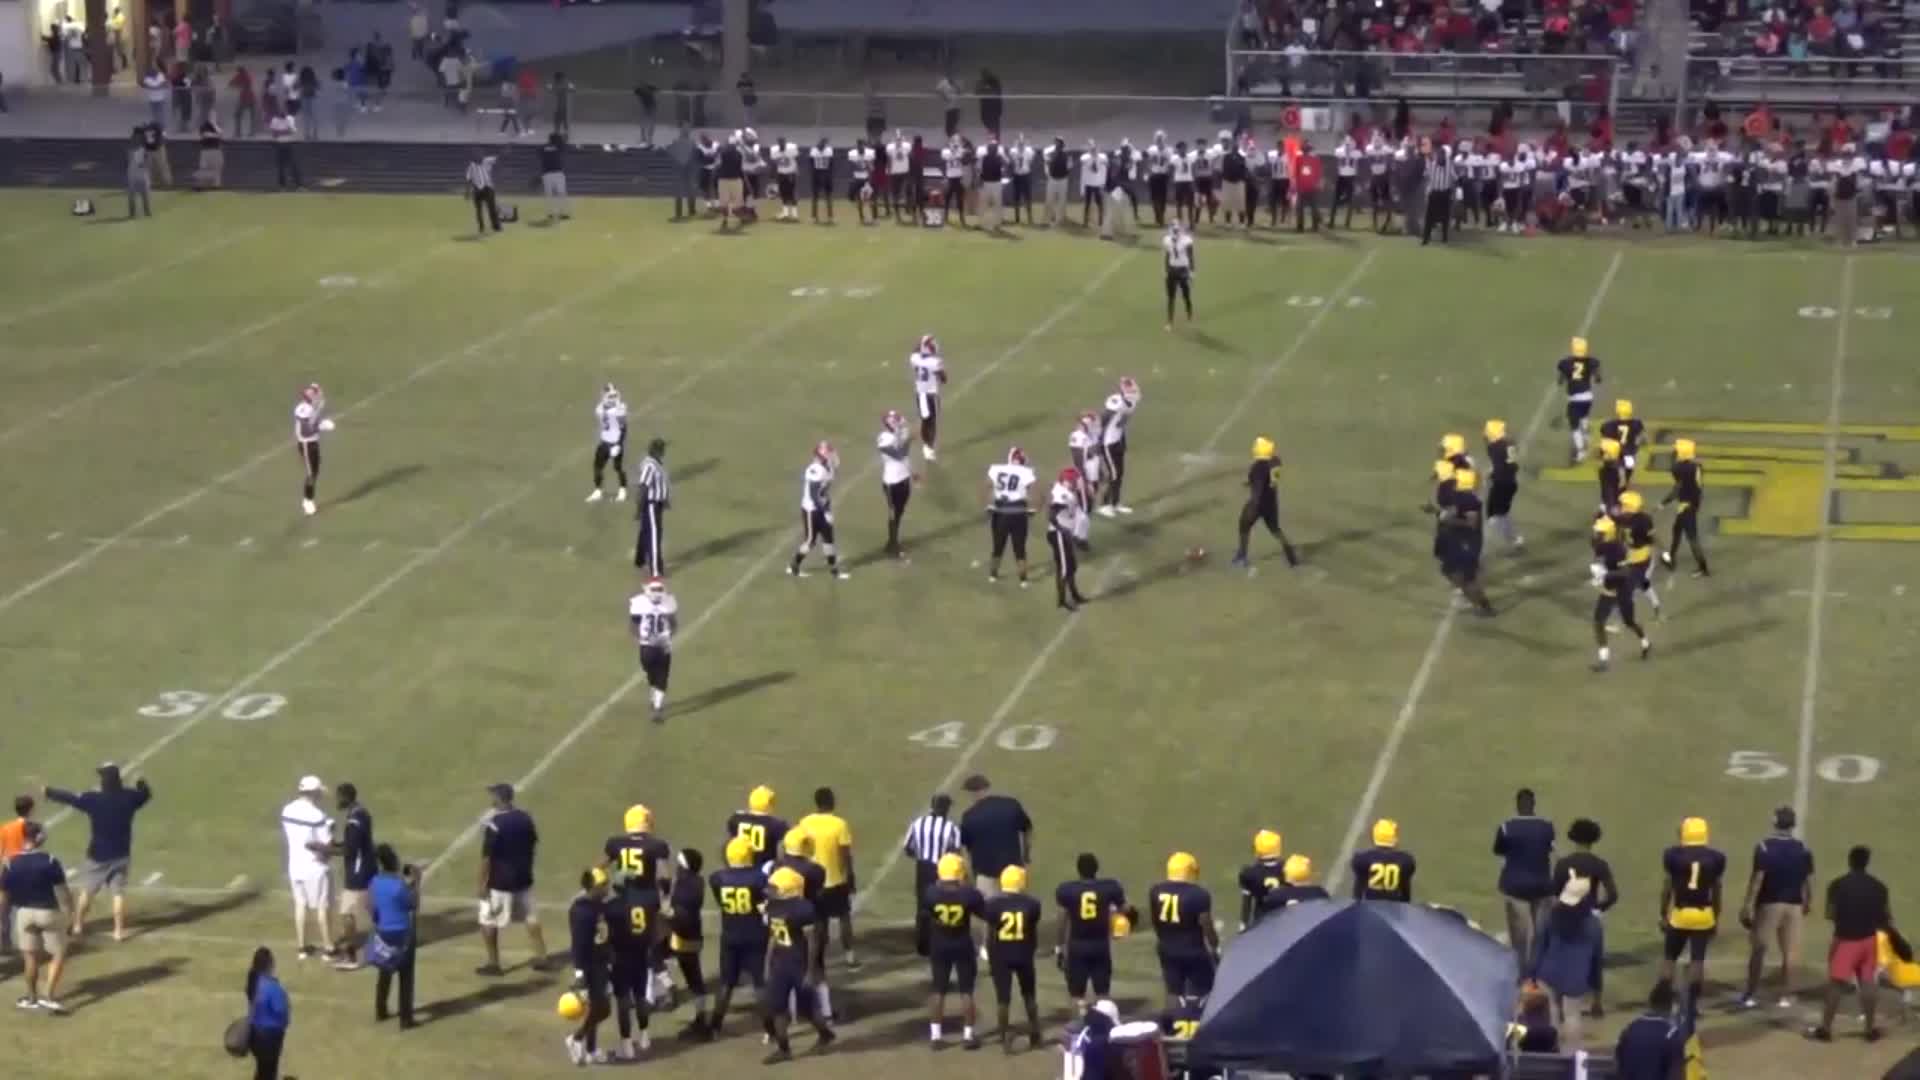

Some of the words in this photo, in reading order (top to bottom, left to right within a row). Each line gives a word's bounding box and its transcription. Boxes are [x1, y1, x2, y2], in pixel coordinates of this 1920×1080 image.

[1572, 361, 1584, 379] 2
[1617, 425, 1629, 444] 7
[137, 690, 288, 720] 30
[908, 720, 1058, 751] 40
[1724, 751, 1879, 783] 50
[620, 847, 644, 876] 15
[1687, 861, 1699, 889] 1
[1368, 863, 1399, 891] 20
[719, 886, 752, 914] 58
[1080, 891, 1097, 920] 6
[1159, 893, 1180, 923] 71
[630, 906, 646, 934] 9
[998, 911, 1024, 940] 21
